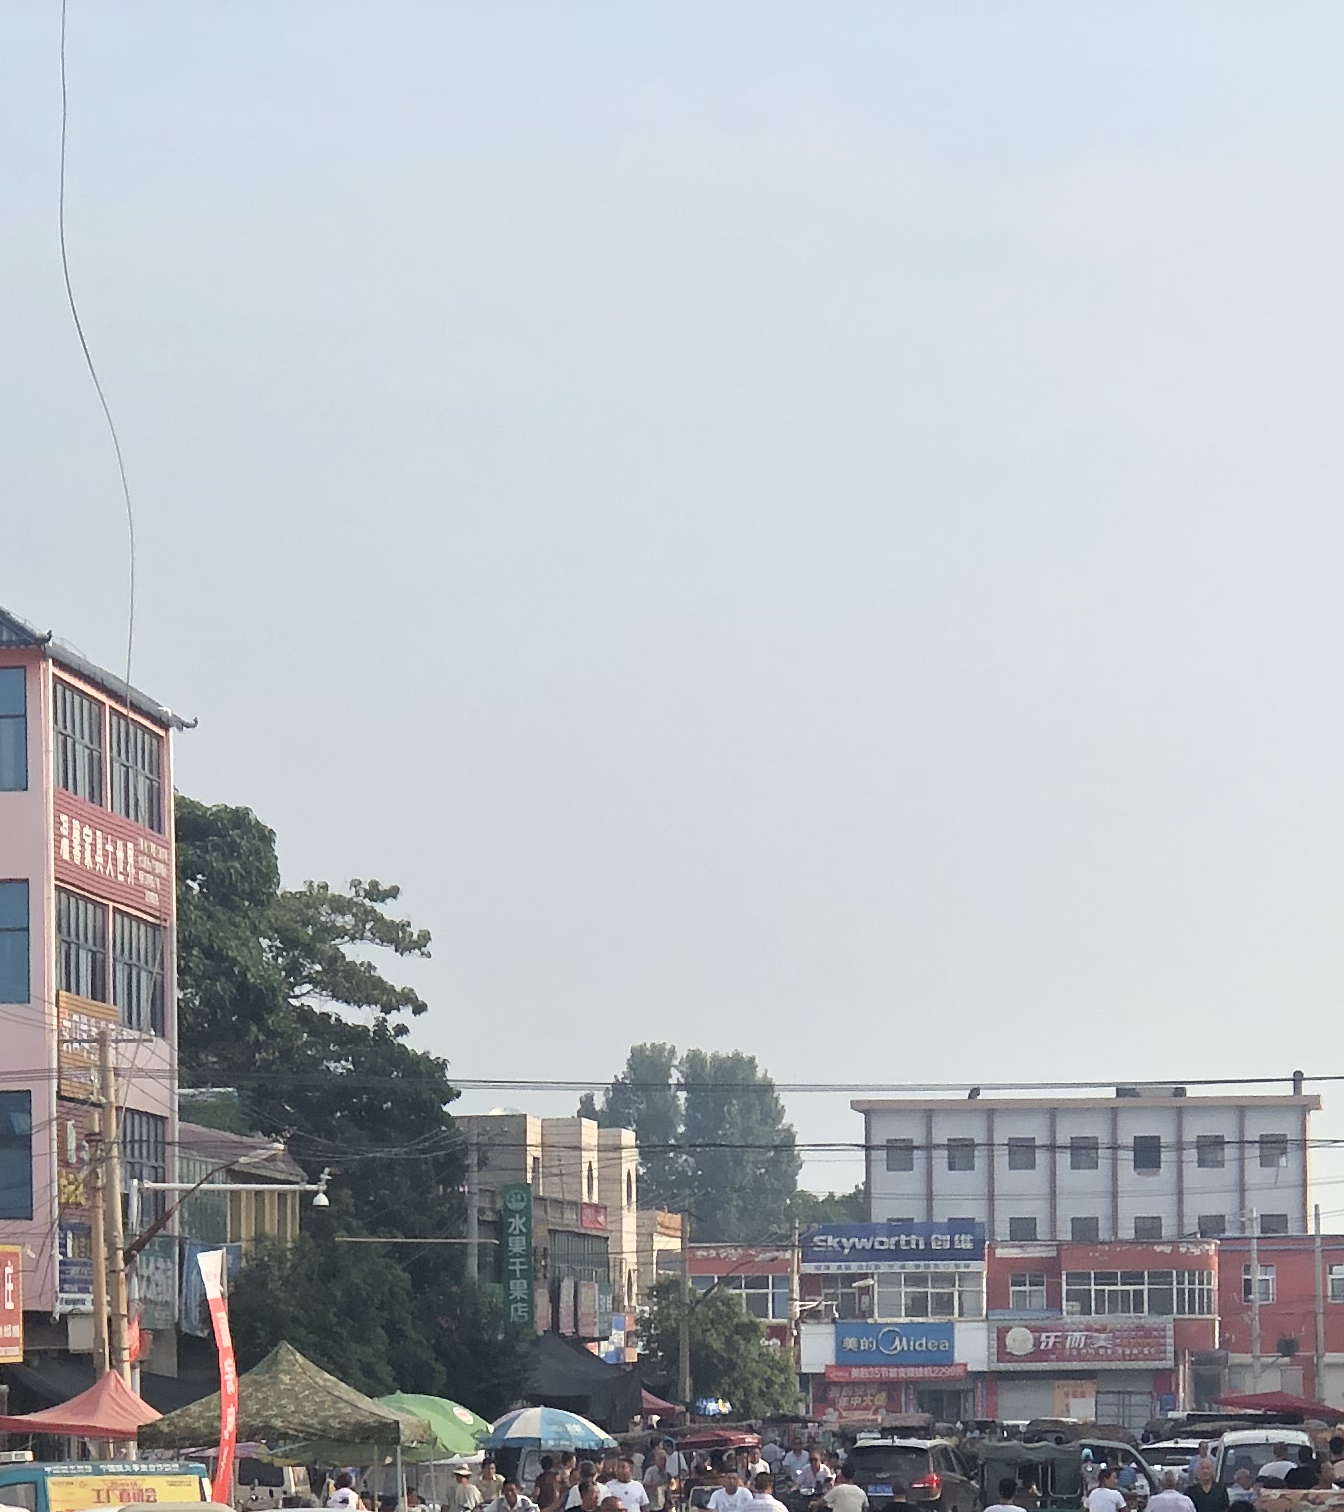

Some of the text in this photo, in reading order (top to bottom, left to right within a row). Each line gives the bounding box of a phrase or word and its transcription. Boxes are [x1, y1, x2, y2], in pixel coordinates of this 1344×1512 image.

[813, 1234, 974, 1255] Skyworth 创维
[508, 1214, 529, 1323] 水果干果店
[842, 1333, 949, 1352] 美的 Midea
